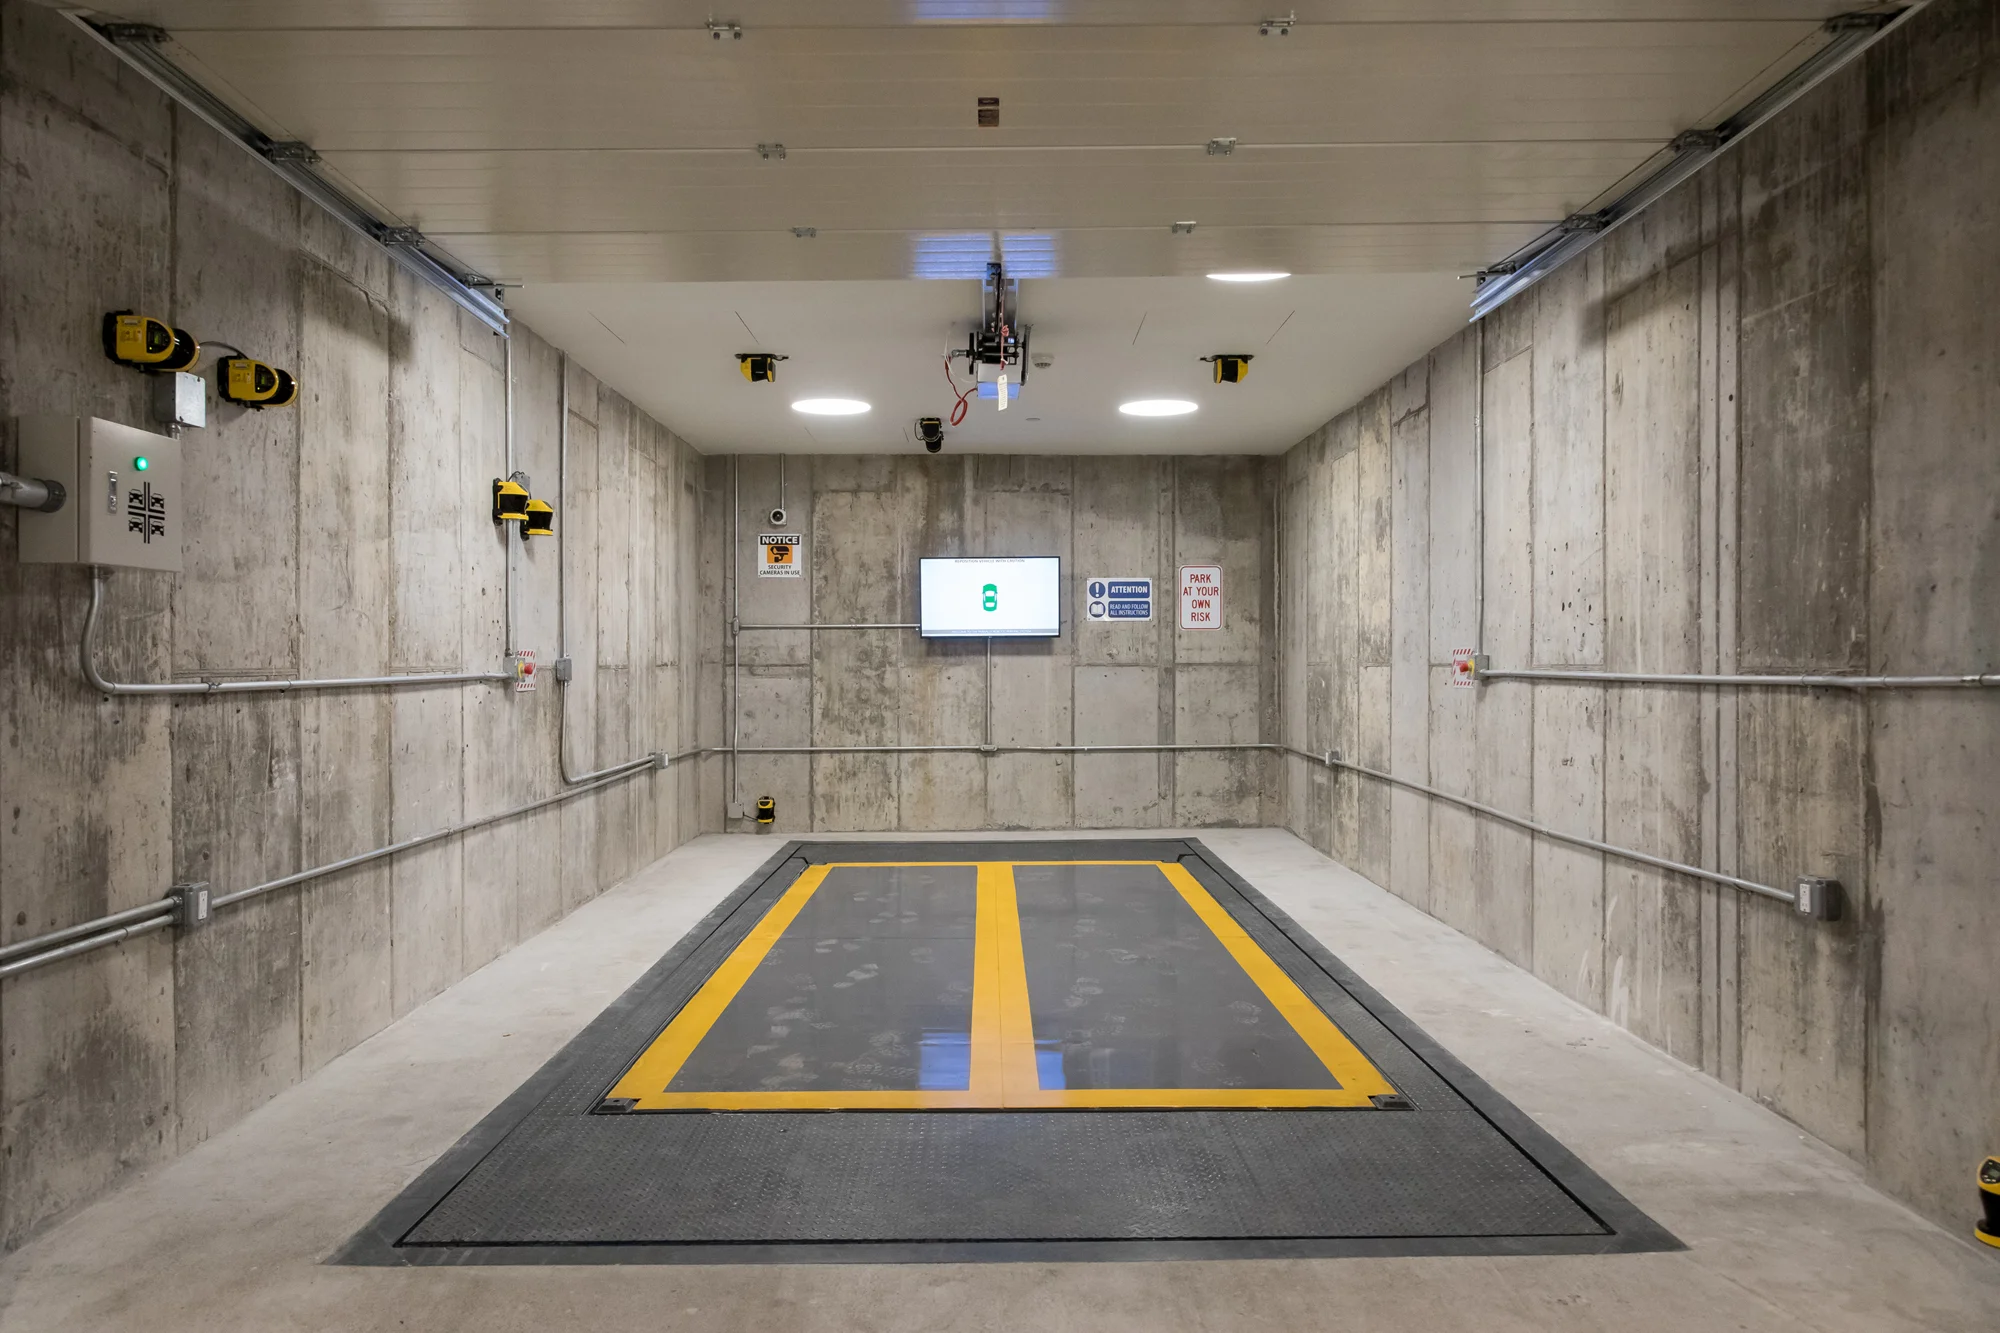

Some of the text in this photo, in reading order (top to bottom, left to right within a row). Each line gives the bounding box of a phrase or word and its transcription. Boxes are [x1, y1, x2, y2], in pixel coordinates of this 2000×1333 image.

[1190, 574, 1212, 583] PARK
[1110, 586, 1148, 594] ATTENTION
[1182, 586, 1219, 596] AT YOUR
[1191, 599, 1210, 609] OWN
[1190, 612, 1210, 622] RISK
